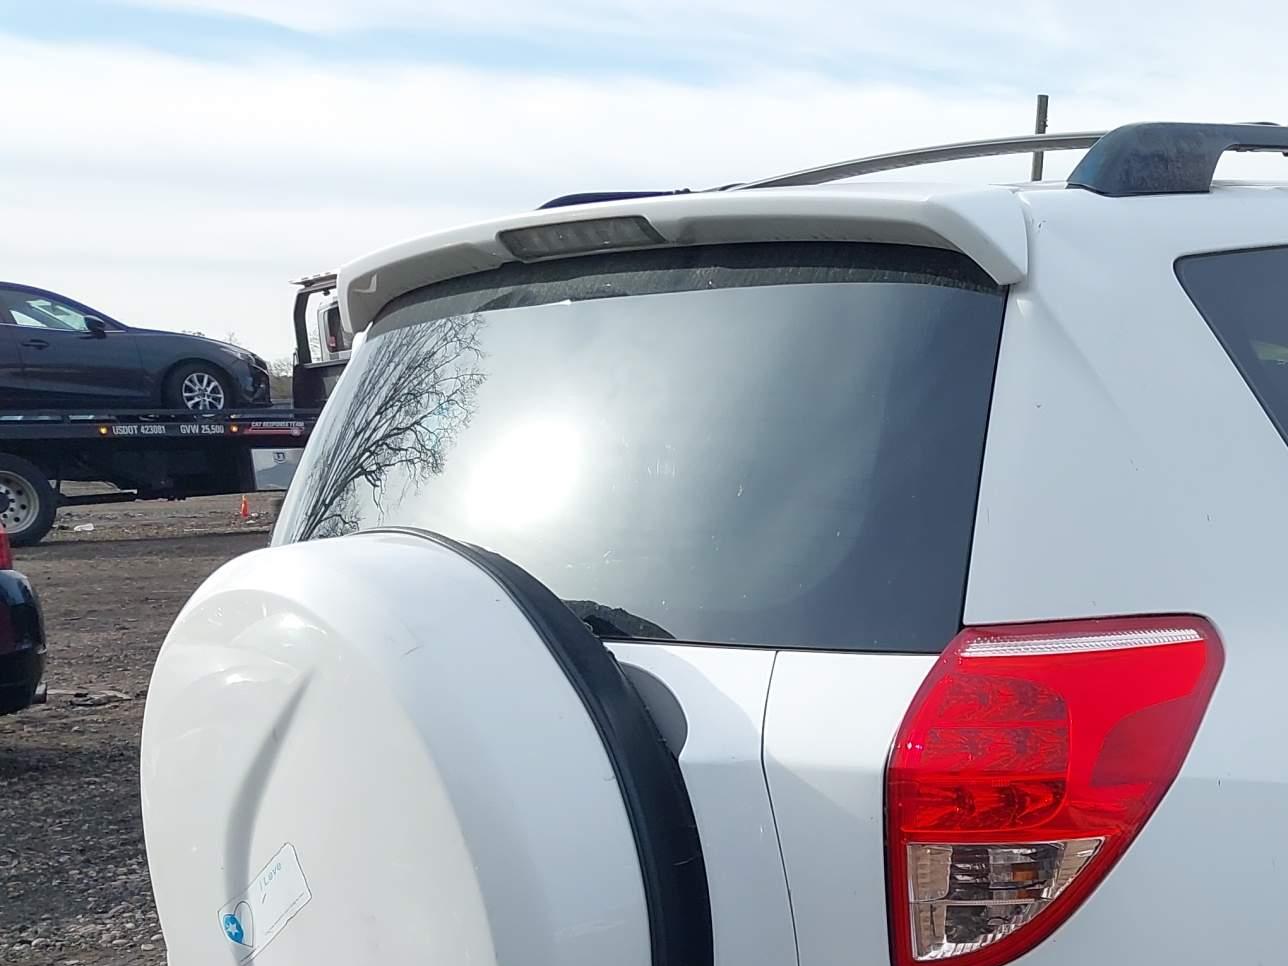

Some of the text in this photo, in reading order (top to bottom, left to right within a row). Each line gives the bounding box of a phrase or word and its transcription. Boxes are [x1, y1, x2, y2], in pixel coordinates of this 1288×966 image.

[112, 425, 138, 435] USDOT
[180, 424, 224, 434] GVW 25,500
